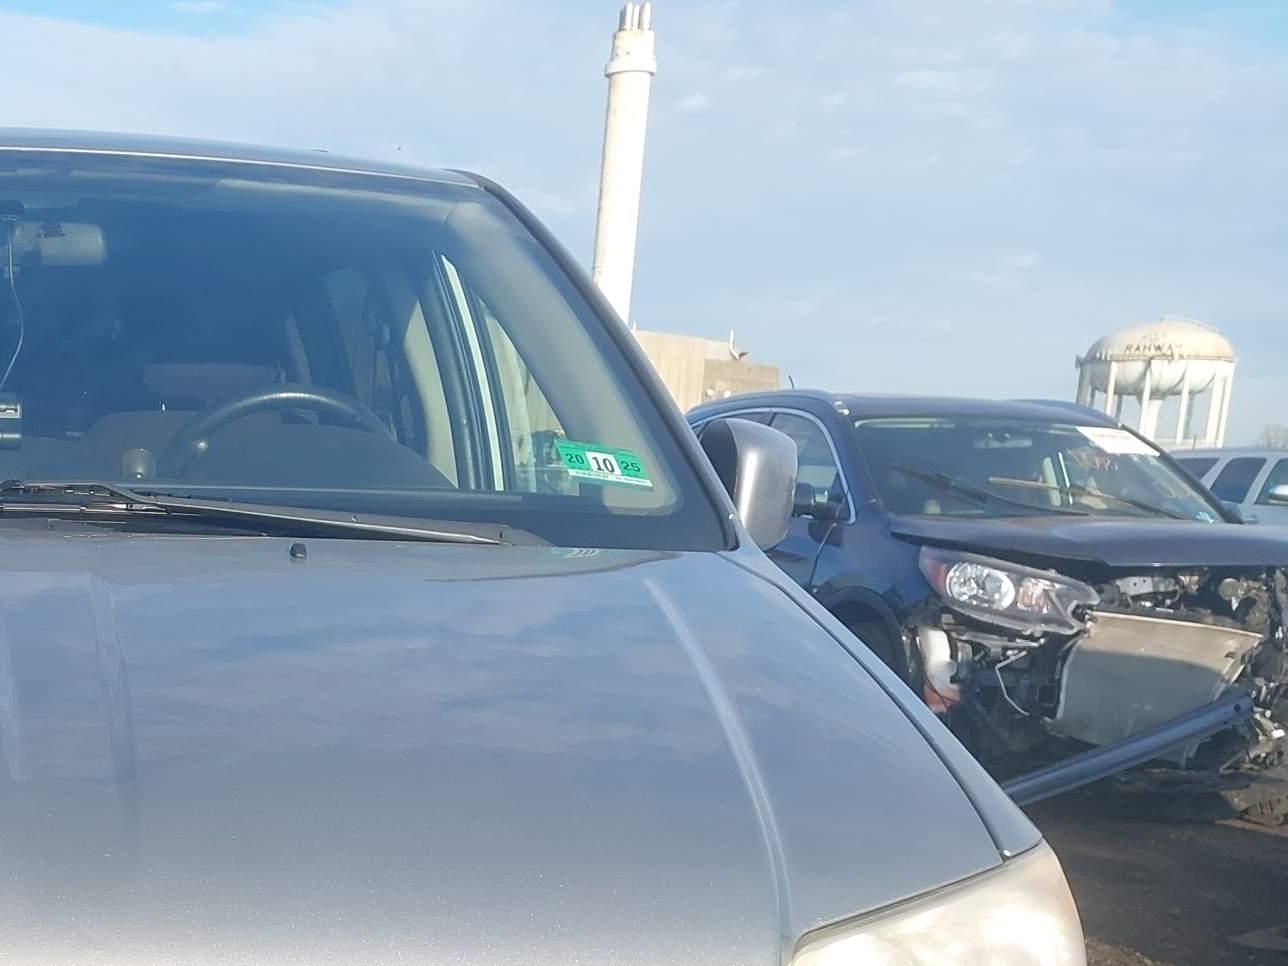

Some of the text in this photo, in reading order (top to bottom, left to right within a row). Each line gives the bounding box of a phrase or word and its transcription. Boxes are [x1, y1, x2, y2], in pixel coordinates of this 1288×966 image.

[565, 453, 641, 473] 20 10 25
